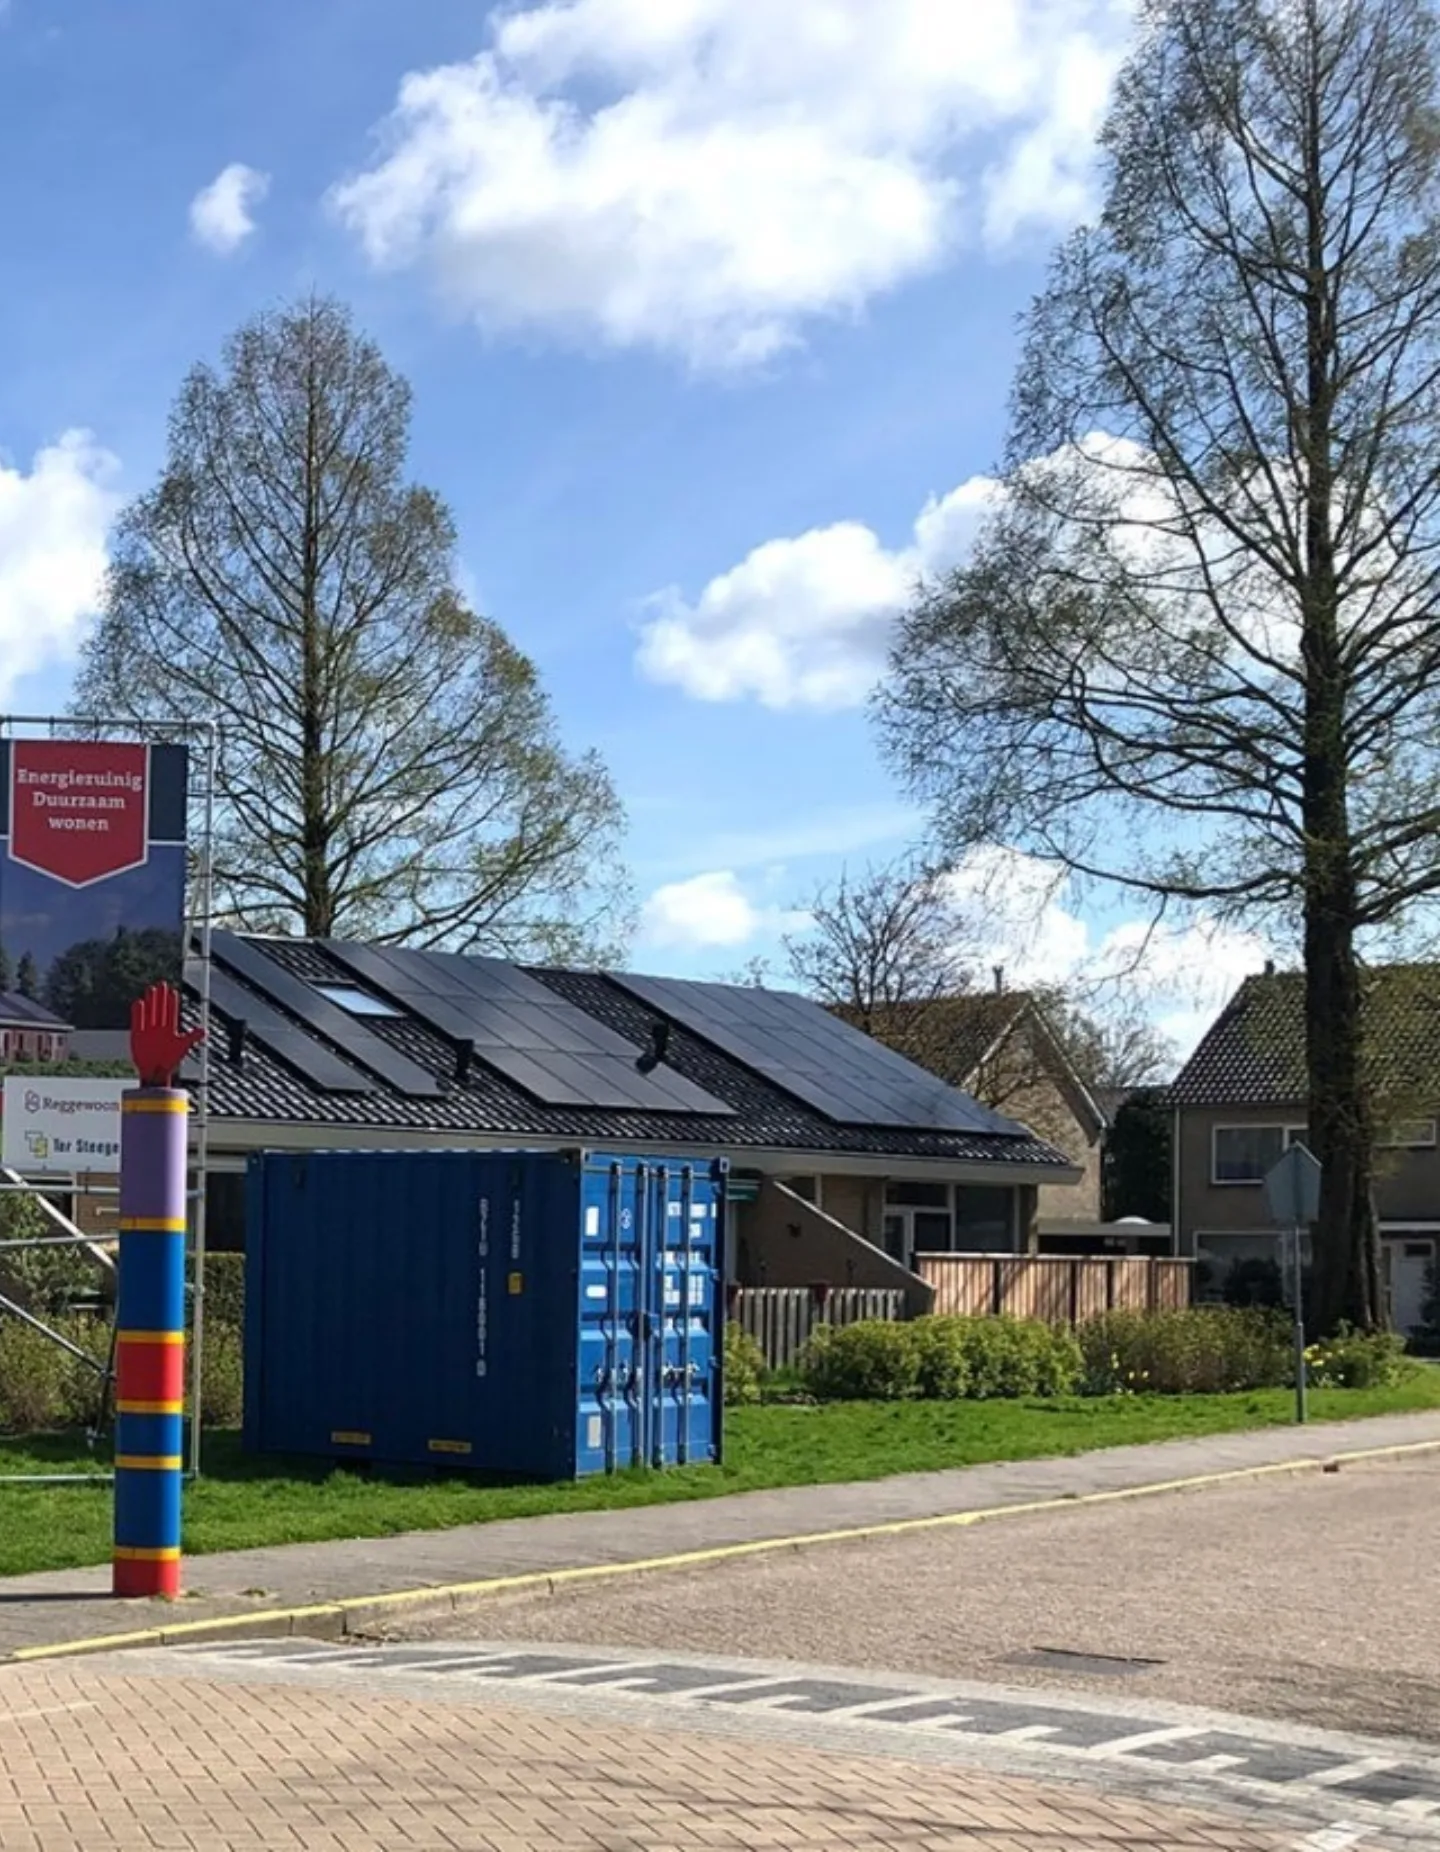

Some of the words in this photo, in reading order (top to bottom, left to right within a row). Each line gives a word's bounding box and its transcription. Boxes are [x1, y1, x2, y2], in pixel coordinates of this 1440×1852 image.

[32, 791, 125, 810] Duurzaam
[48, 816, 109, 832] wonen
[53, 1138, 72, 1153] Ter
[76, 1138, 120, 1157] Steege
